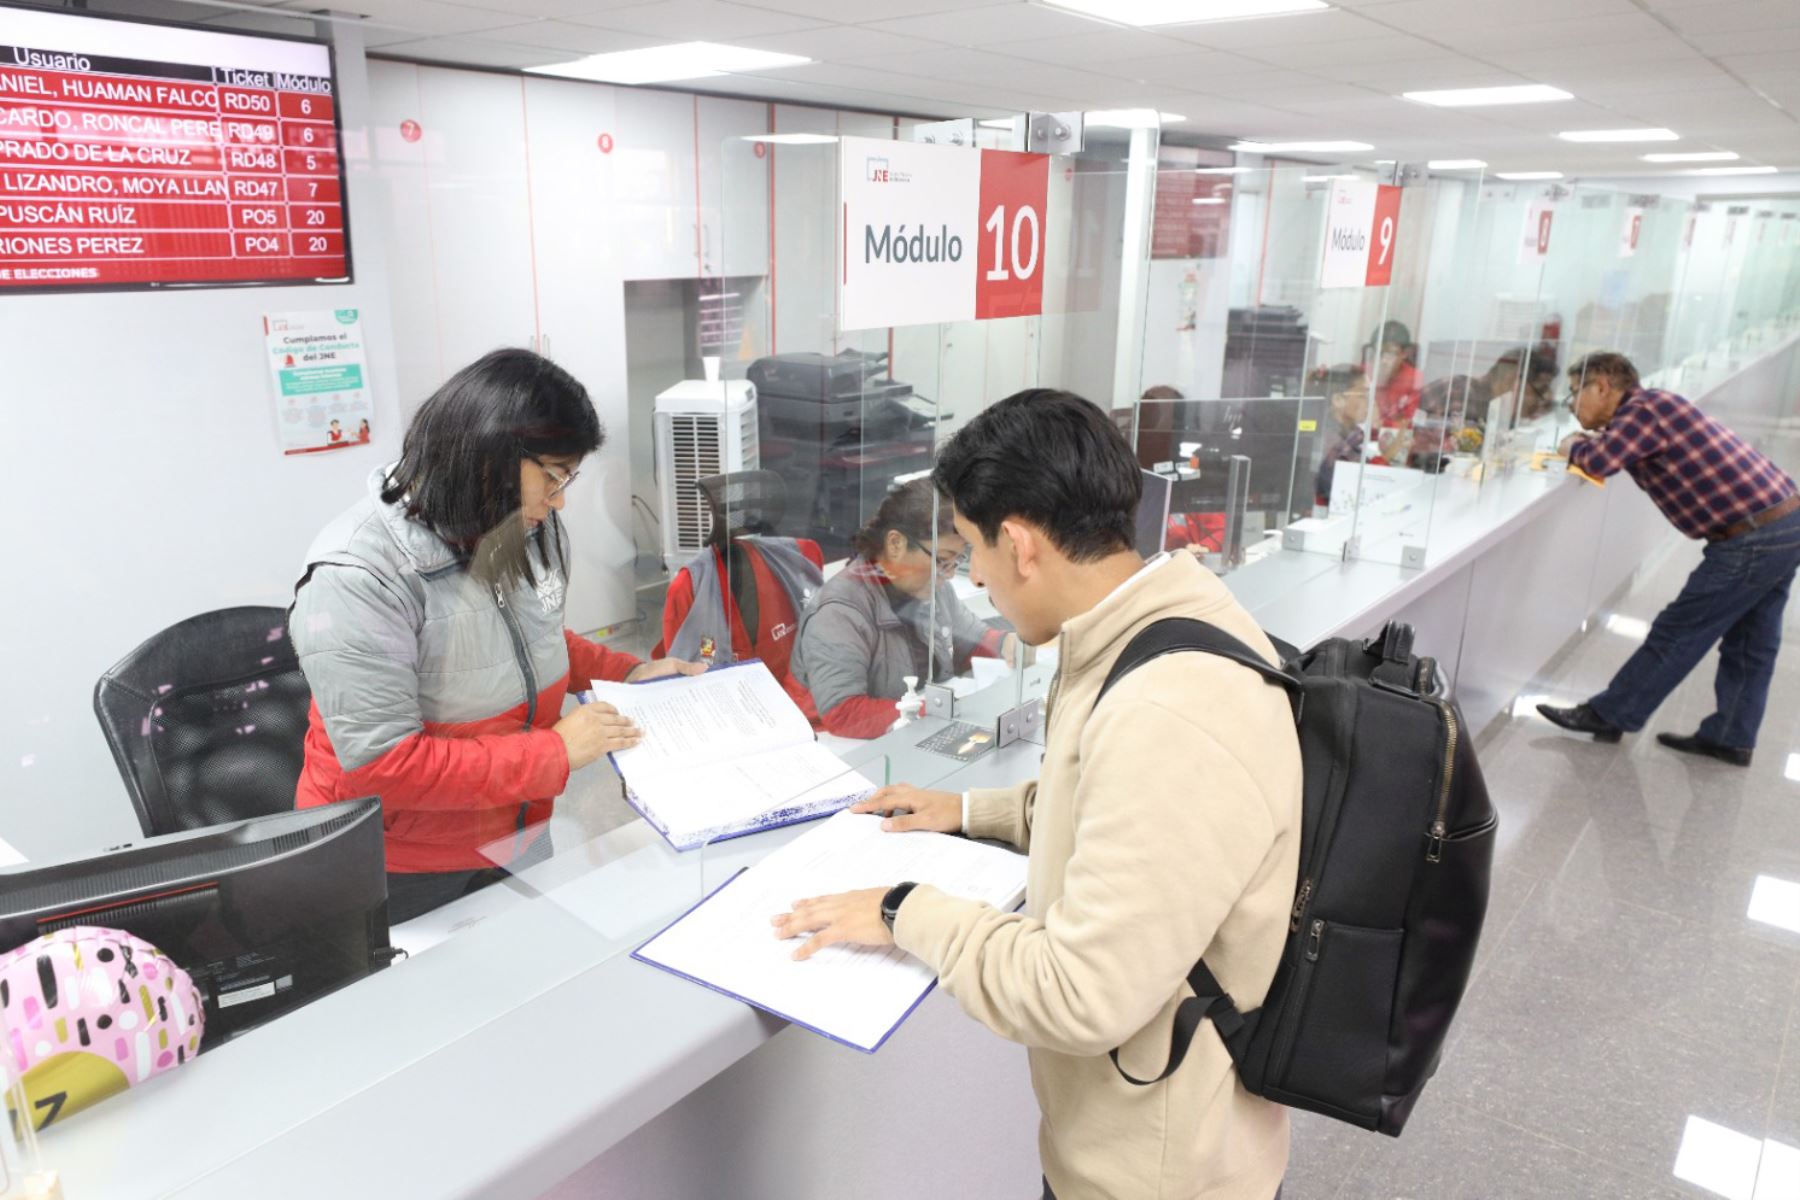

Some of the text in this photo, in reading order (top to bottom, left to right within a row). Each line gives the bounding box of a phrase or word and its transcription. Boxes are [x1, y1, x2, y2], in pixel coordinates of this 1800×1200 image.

[14, 47, 331, 93] Usuario Ticket Módulo
[0, 74, 58, 97] NIEL,
[62, 79, 152, 102] HUAMAN
[225, 92, 270, 111] RD50
[301, 99, 311, 114] 6
[82, 113, 164, 133] RONCAL
[171, 119, 220, 138] PERE
[228, 122, 273, 141] RD49
[304, 128, 313, 142] 6
[73, 144, 103, 161] DE
[107, 148, 133, 163] LA
[137, 148, 191, 165] CRUZ
[231, 152, 276, 169] RD48
[306, 155, 316, 170] 5
[4, 173, 317, 197] LIZANDRO, MOYA LLAN RD47 7
[872, 169, 888, 182] JNE
[88, 204, 136, 224] RUÍZ
[242, 209, 277, 224] PO5
[306, 210, 325, 225] 20
[77, 237, 144, 254] PEREZ
[245, 237, 279, 252] PO4
[309, 237, 327, 251] 20
[865, 205, 1040, 281] Módulo 10
[1331, 216, 1393, 265] Módulo 9
[14, 268, 99, 280] ELECCIONES
[283, 333, 348, 344] Cumplamos el
[303, 352, 336, 361] del JNE
[542, 590, 562, 612] JNE
